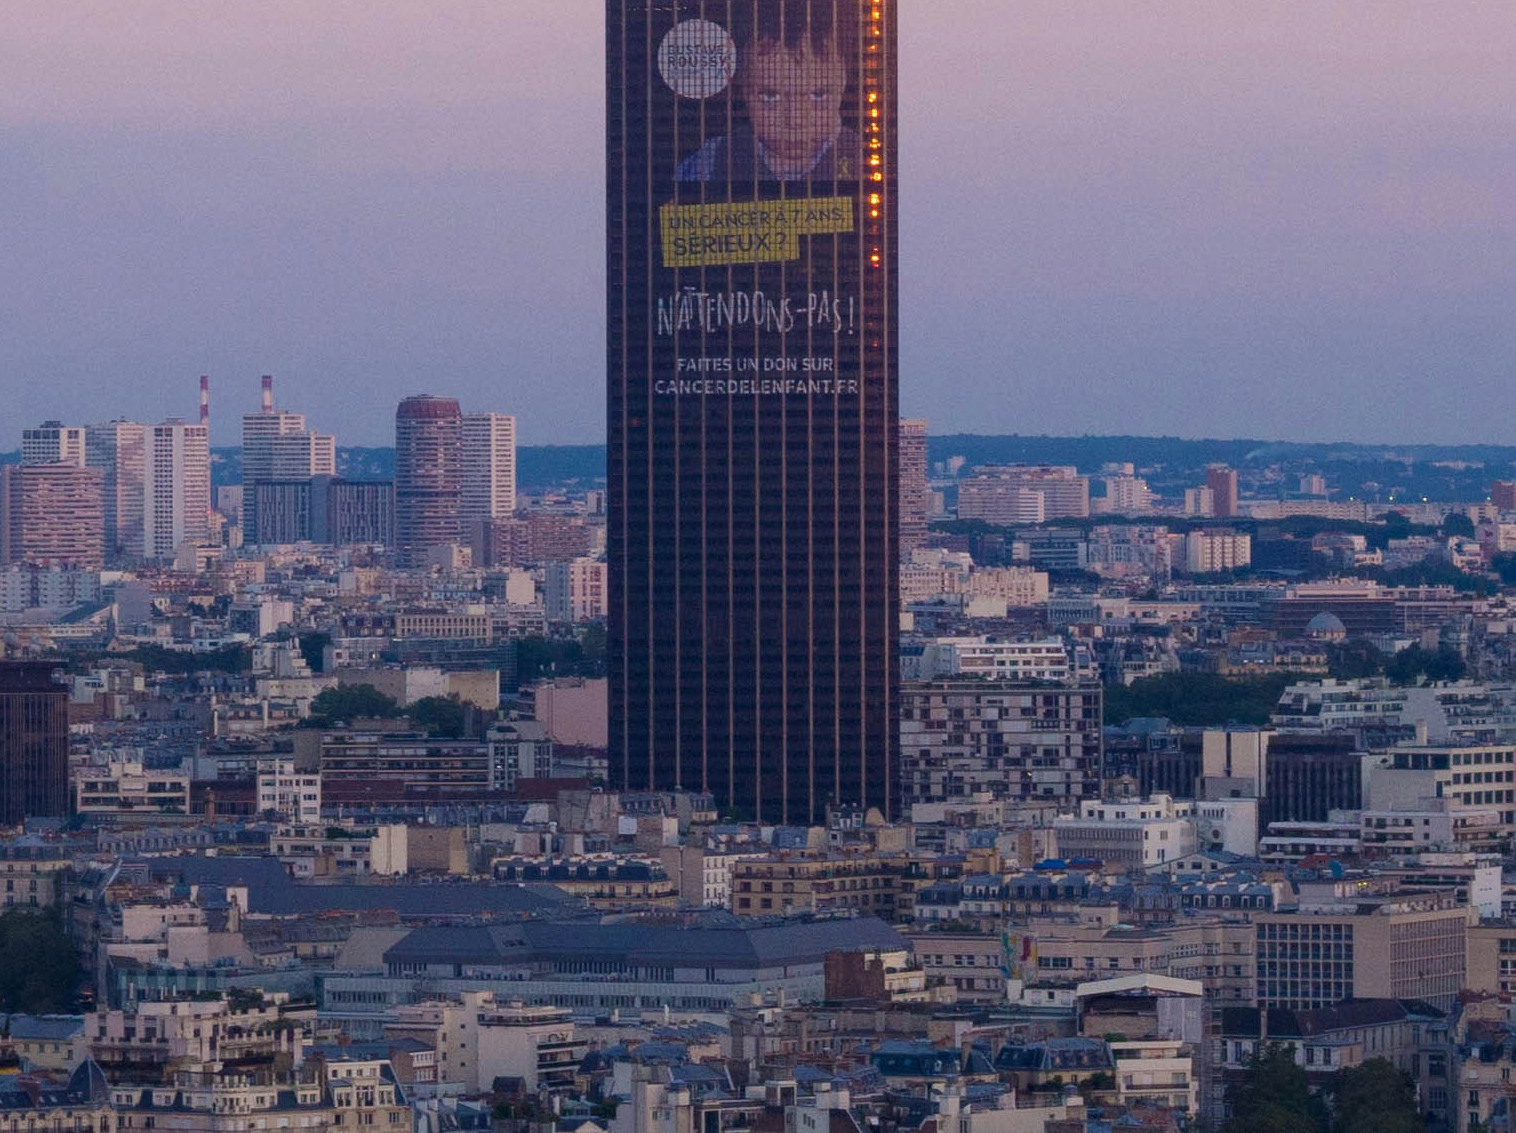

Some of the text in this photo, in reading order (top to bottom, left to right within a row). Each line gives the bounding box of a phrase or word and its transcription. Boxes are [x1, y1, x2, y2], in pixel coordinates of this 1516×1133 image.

[668, 56, 730, 68] ROUSSY
[669, 216, 694, 229] UN
[699, 210, 770, 229] CANCER
[790, 209, 800, 223] 7
[673, 231, 771, 256] SÉRIEUX
[677, 357, 834, 372] FAITES UN DON SUR
[655, 379, 859, 395] CANCERDELENFANT.FR
